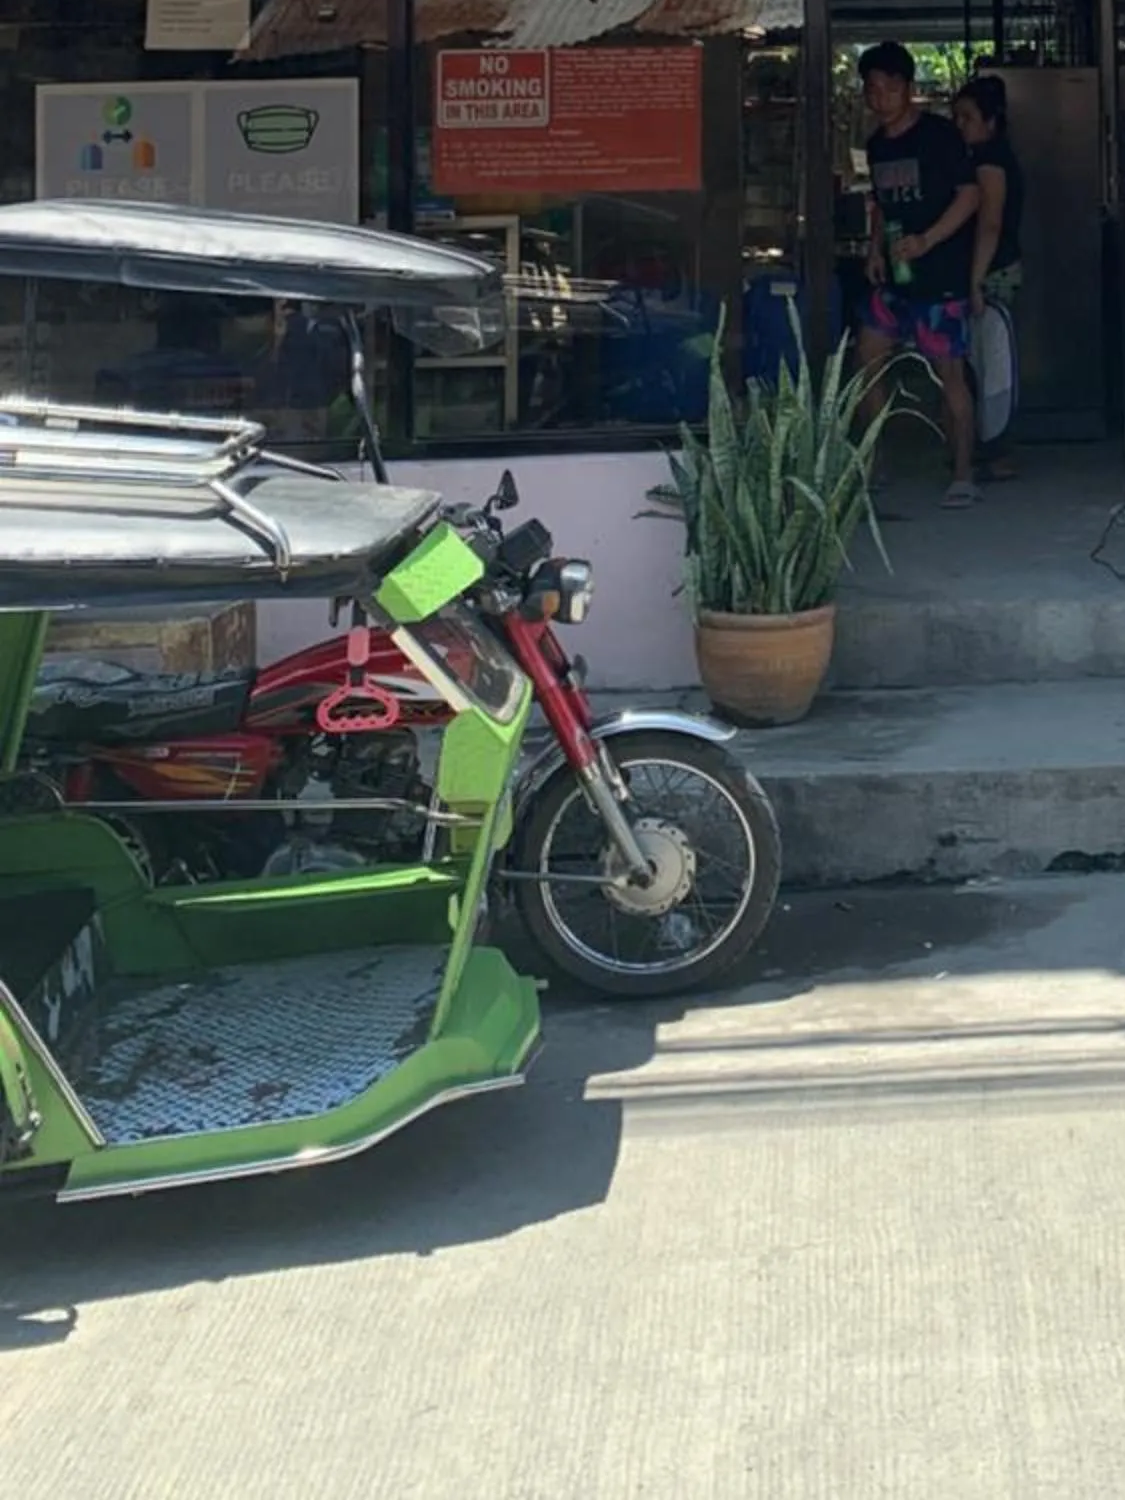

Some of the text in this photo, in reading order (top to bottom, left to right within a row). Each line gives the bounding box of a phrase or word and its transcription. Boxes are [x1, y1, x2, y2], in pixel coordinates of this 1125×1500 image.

[479, 55, 509, 75] NO
[445, 78, 542, 98] SMOKING
[445, 101, 541, 120] IN THIS AREA
